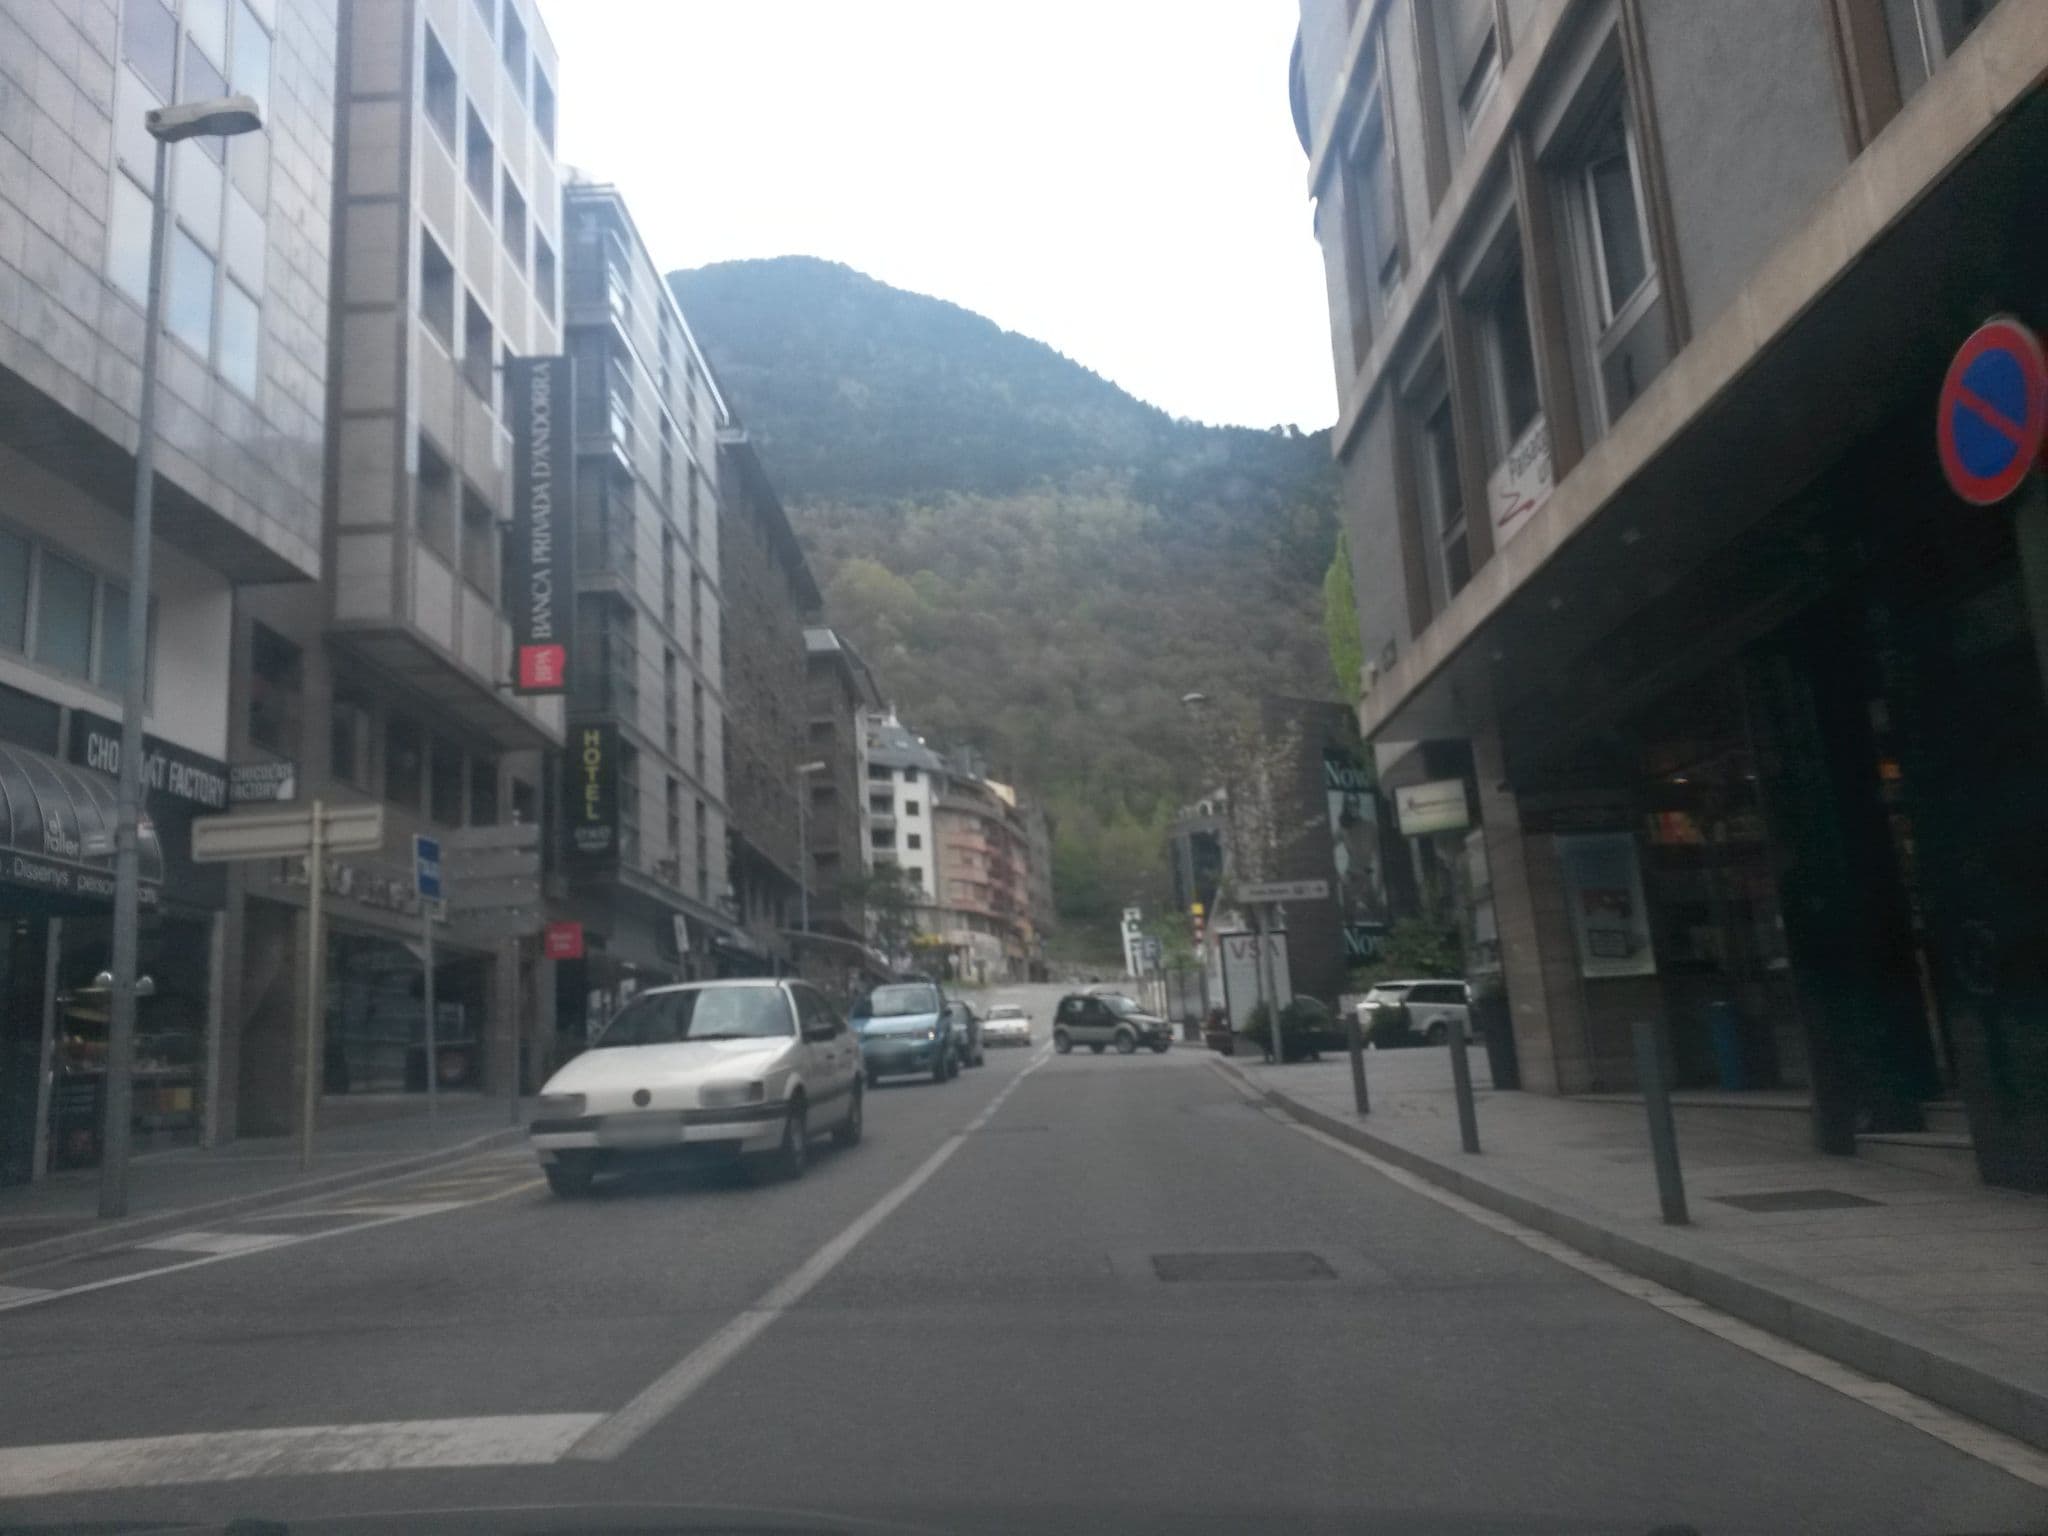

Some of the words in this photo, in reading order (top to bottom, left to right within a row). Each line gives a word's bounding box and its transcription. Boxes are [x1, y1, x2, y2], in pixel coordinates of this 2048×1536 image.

[531, 361, 552, 477] D'ANDORRA
[531, 482, 552, 564] PRIVADA
[531, 568, 552, 638] BANCA
[169, 759, 226, 809] FACTORY
[583, 728, 601, 820] HOTEL
